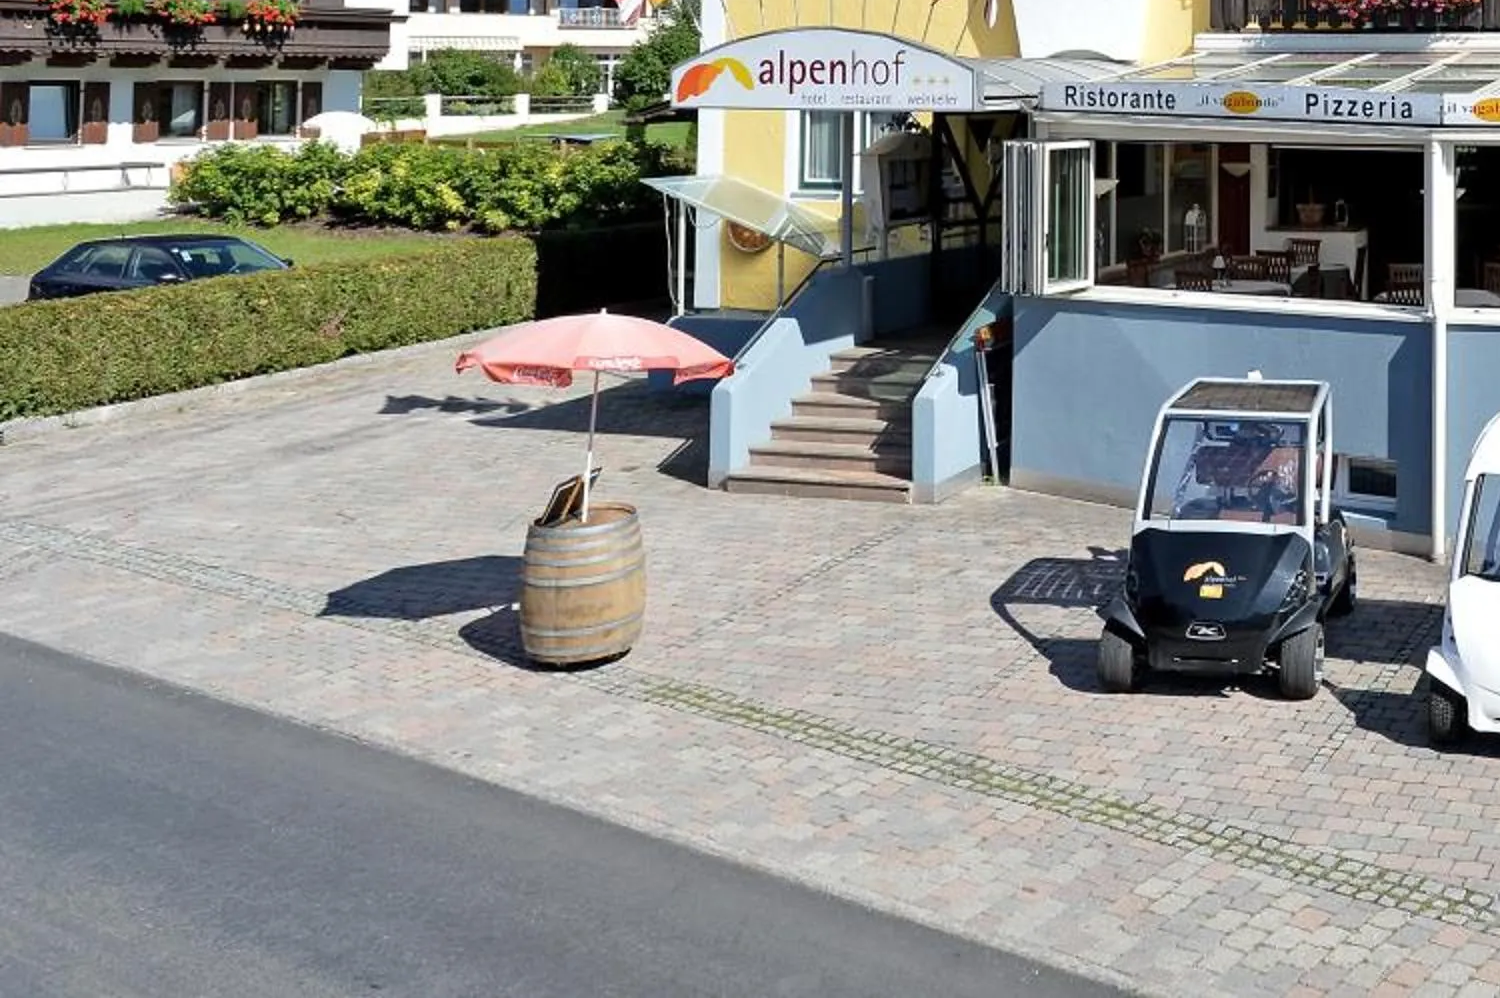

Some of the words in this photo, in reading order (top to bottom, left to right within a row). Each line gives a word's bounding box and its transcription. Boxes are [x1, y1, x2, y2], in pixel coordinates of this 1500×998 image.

[759, 49, 906, 94] alpenhof
[1065, 85, 1176, 110] Ristorante
[1305, 93, 1413, 119] Pizzeria
